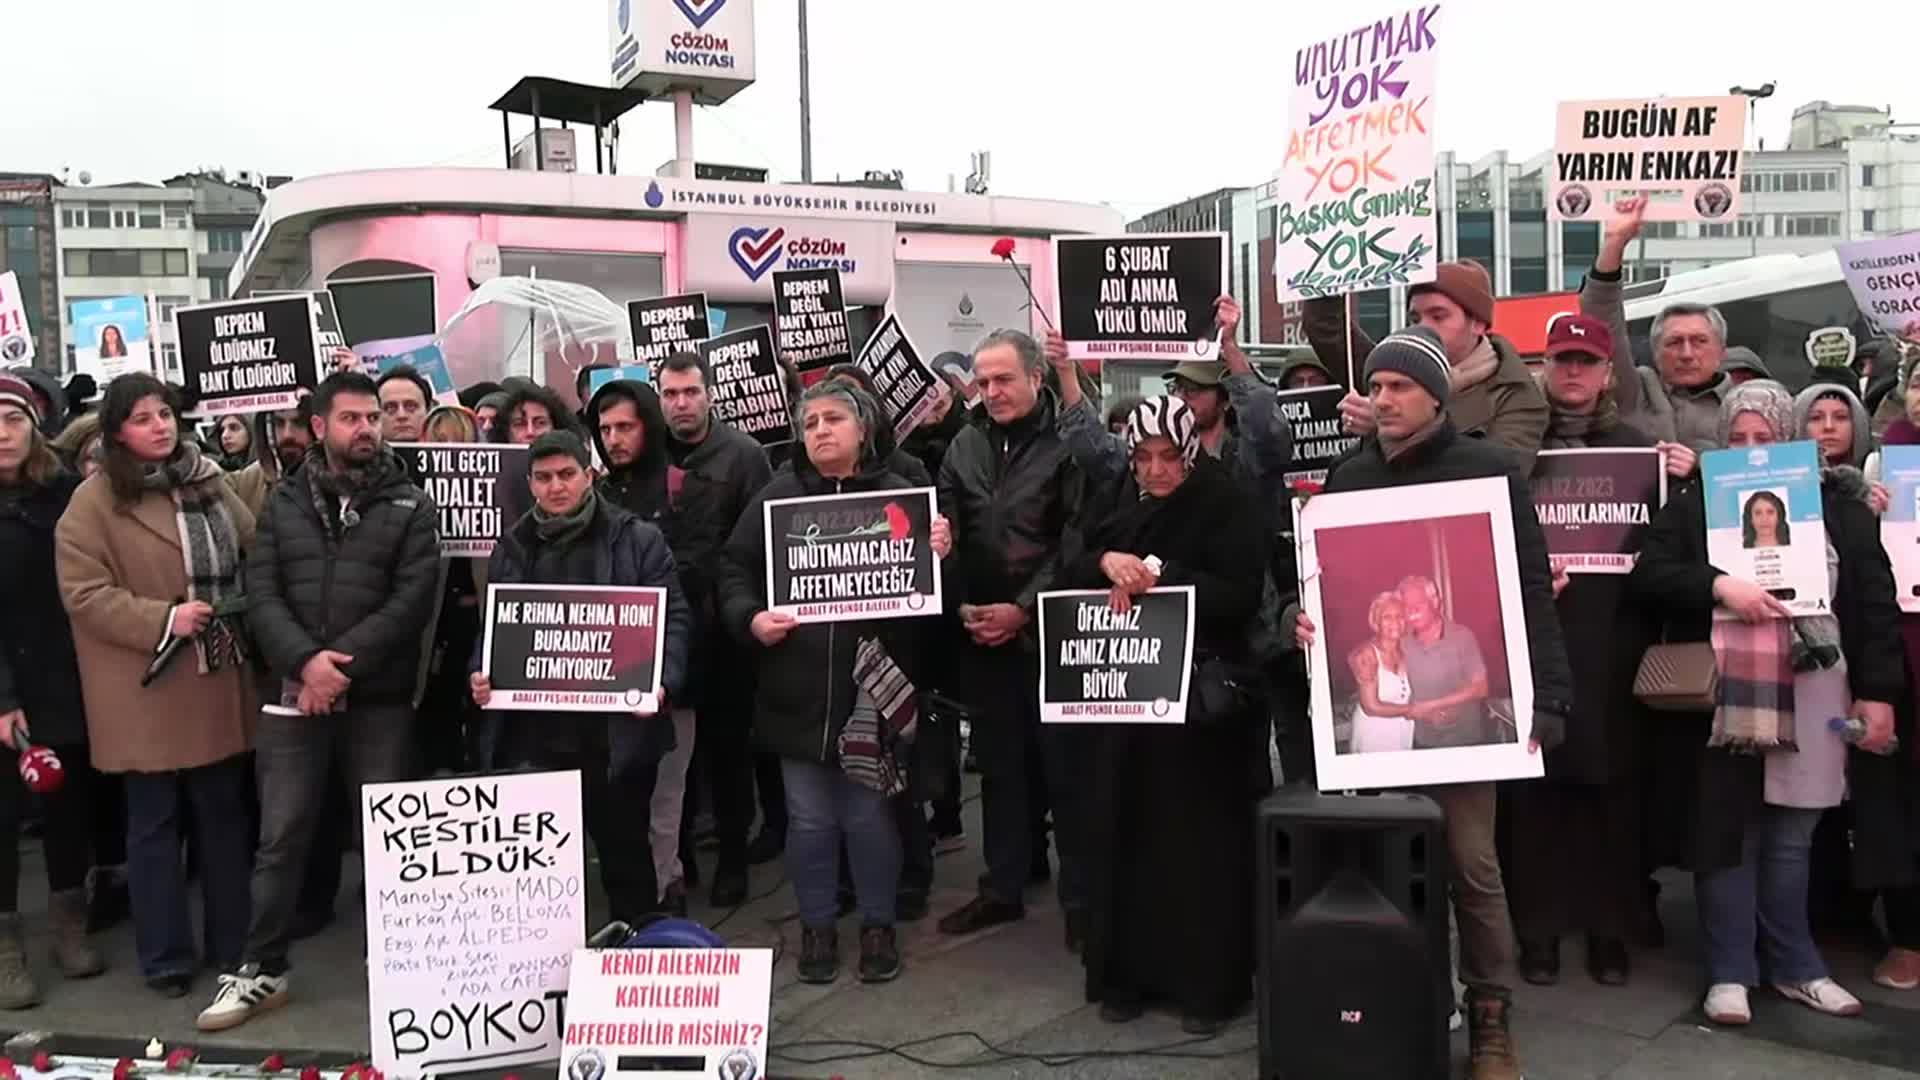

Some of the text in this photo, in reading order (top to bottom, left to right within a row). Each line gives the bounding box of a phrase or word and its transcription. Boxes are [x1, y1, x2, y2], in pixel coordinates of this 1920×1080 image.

[671, 33, 728, 51] ÇÖZÜM
[666, 50, 734, 68] NOKTASI
[1582, 103, 1717, 139] BUGÜN AF
[1305, 144, 1397, 202] YOK
[1557, 150, 1738, 181] YARIN ENKAZ!
[672, 188, 937, 215] İSTANBUL BÜYÜKŞEHİR BELEDİYESİ
[787, 237, 846, 256] ÇÖZÜM
[1303, 226, 1402, 280] YOK
[1105, 245, 1171, 276] 6 ŞUBAT
[783, 279, 830, 297] DEPREM
[1100, 278, 1178, 303] ADI ANMA
[641, 305, 695, 326] DEPREM
[790, 296, 824, 314] DEĞİL
[213, 311, 265, 337] DEPREM
[651, 323, 690, 342] DEĞİL
[780, 311, 843, 330] RANT YIKTI
[1094, 307, 1187, 334] YÜKÜ ÖMÜR
[780, 326, 847, 348] HESABINI
[210, 337, 277, 365] ÖLDÜRMEZ
[709, 339, 760, 366] DEPREM
[200, 361, 297, 393] RANT ÖLDÜRÜR!
[716, 358, 756, 383] DEĞİL
[740, 374, 778, 396] YIKTI
[1294, 419, 1340, 440] KALMAK
[417, 450, 500, 476] 3 YIL GEÇTİ
[424, 477, 497, 507] ADALET
[436, 507, 502, 537] LMEDİ
[1534, 503, 1650, 525] MADIKLARIMIZA
[790, 566, 915, 600] AFFETMEYECEĞİZ
[497, 602, 654, 626] ME RİHNA NEHNA HON!
[534, 630, 612, 653] BURADAYIZ
[1060, 637, 1161, 666] ACIMIZ KADAR
[526, 656, 616, 680] GİTMİYORUZ.
[1083, 669, 1128, 698] BÜYÜK
[369, 784, 499, 824] KOLON
[516, 876, 579, 904] MADO
[601, 949, 740, 975] KENDİ AİLENİZİN
[616, 980, 720, 1008] KATİLLERİNİ
[388, 991, 567, 1060] BOYKOT
[566, 1017, 763, 1046] AFFEDEBİLİR MİSİNİZ?
